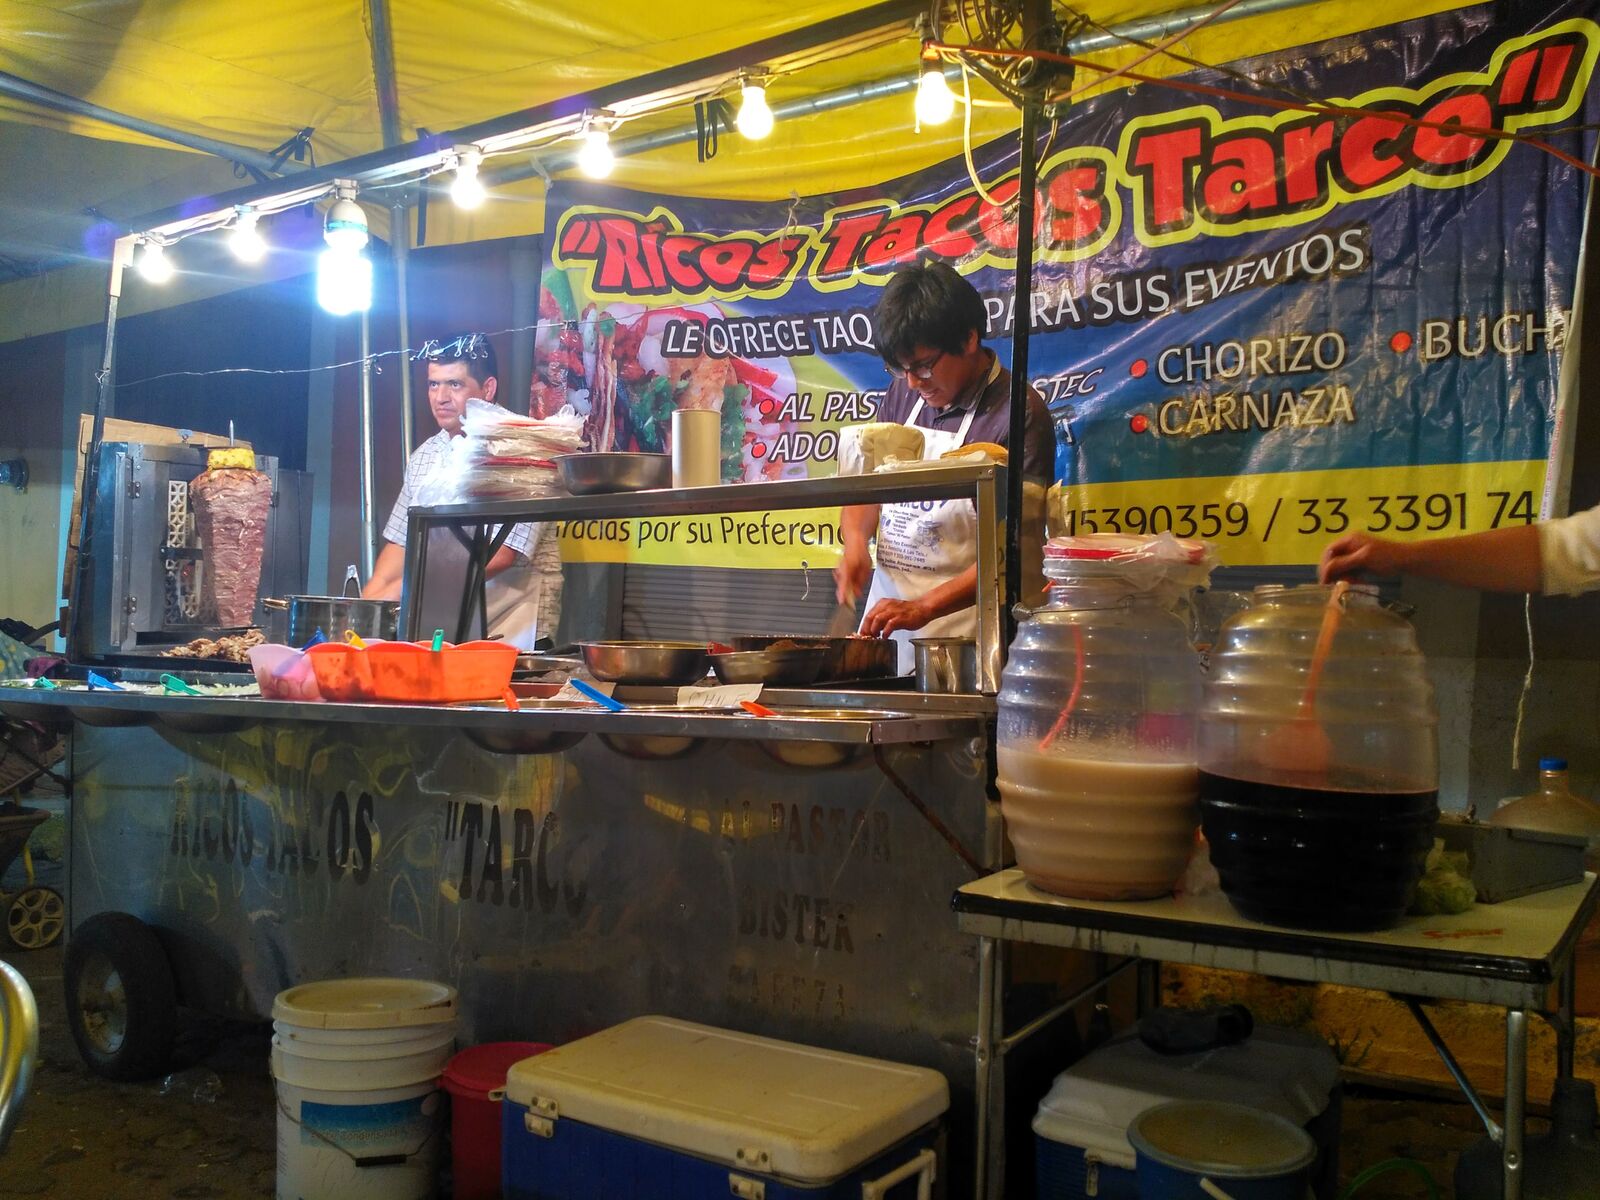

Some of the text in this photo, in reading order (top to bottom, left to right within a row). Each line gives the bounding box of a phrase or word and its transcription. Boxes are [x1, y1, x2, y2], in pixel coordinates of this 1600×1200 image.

[822, 166, 1105, 274] Tacos
[666, 325, 700, 353] LE
[709, 319, 810, 354] OFRECE
[813, 313, 876, 350] TAQ
[1091, 274, 1171, 320] SUS
[1185, 228, 1365, 308] EVENTOS
[1158, 332, 1346, 384] CHORIZO
[778, 394, 814, 420] AL
[1032, 368, 1104, 404] STEC
[1159, 386, 1355, 435] CARNAZA
[770, 431, 838, 461] ADO
[556, 512, 845, 549] racias por su Preferenc
[1067, 501, 1249, 537] 15390359
[1262, 498, 1284, 542] /
[1297, 498, 1350, 535] 33
[1366, 492, 1467, 533] 3391
